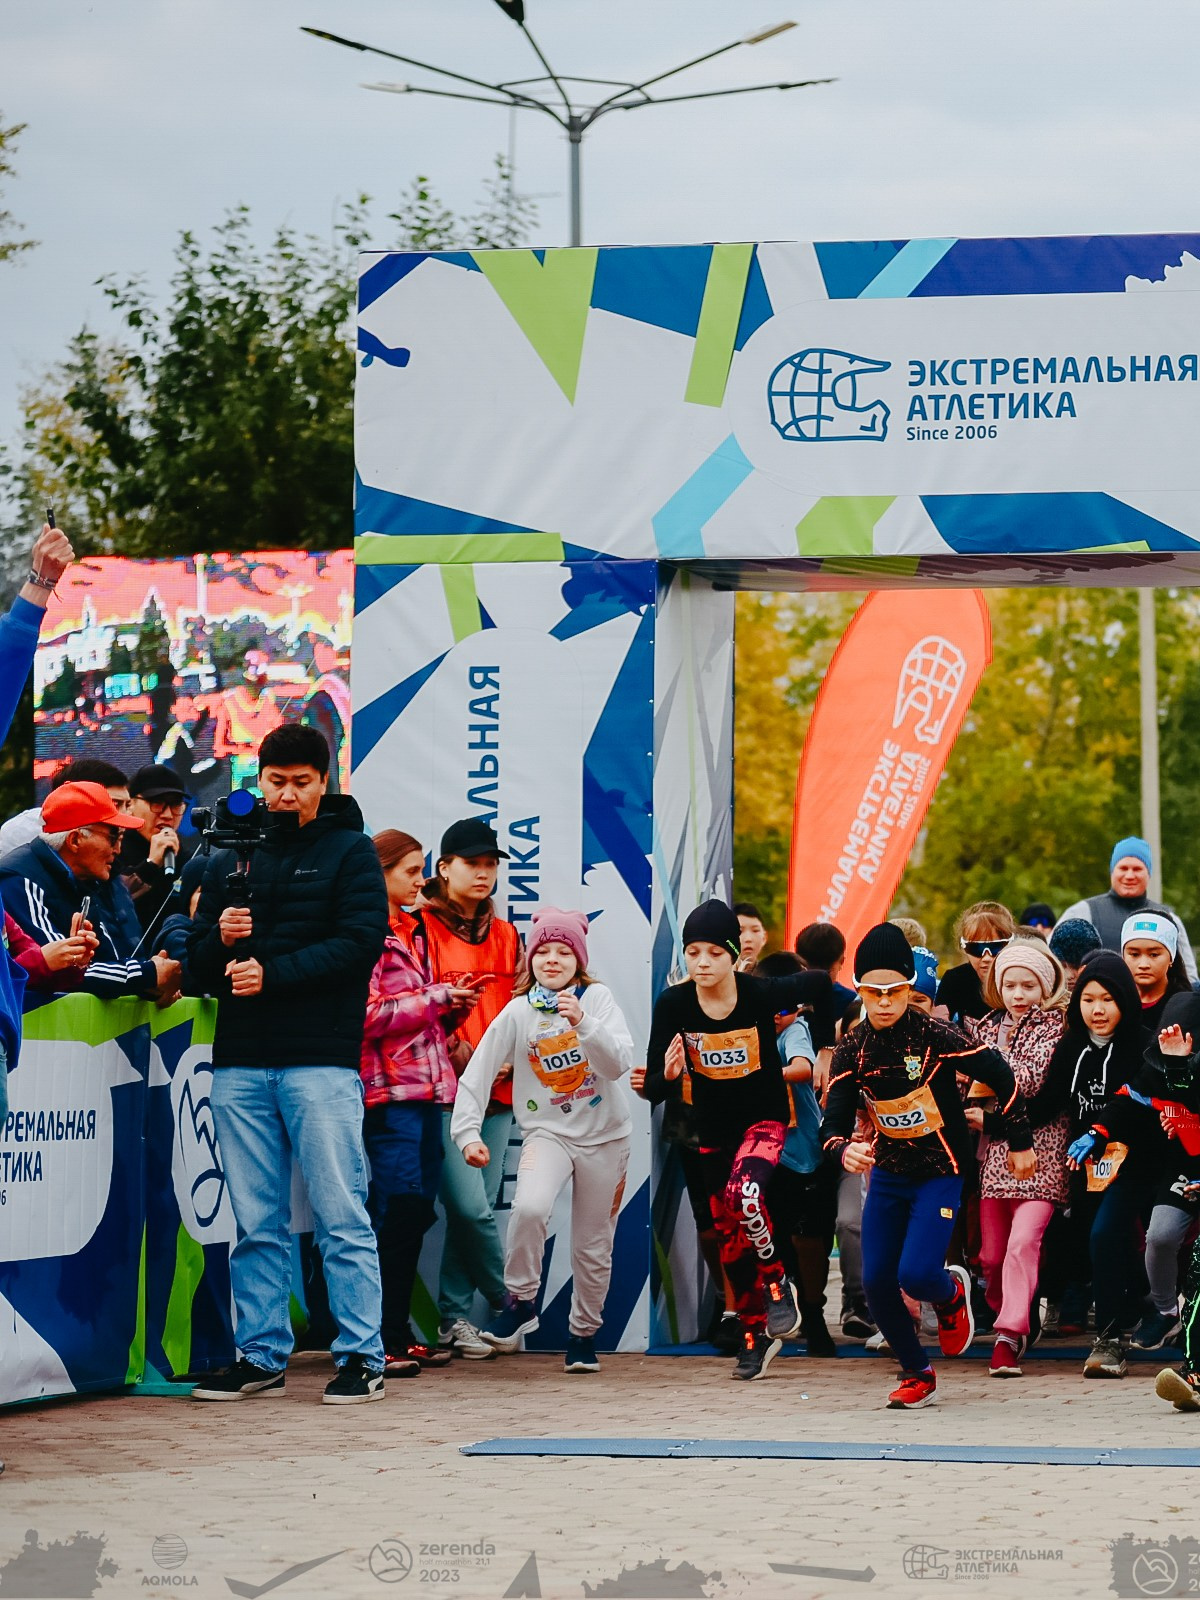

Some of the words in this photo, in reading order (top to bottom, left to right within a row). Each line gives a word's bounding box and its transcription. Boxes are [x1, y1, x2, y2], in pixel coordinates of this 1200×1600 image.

[908, 354, 1198, 387] ЭКСТРЕМАЛЬНАЯ
[906, 391, 1077, 421] АТЛЕТИКА
[906, 426, 949, 441] Since
[955, 425, 998, 440] 2006
[543, 1049, 582, 1071] 1015
[701, 1049, 746, 1066] 1033
[878, 1110, 925, 1128] 1032
[739, 1181, 776, 1260] adidas
